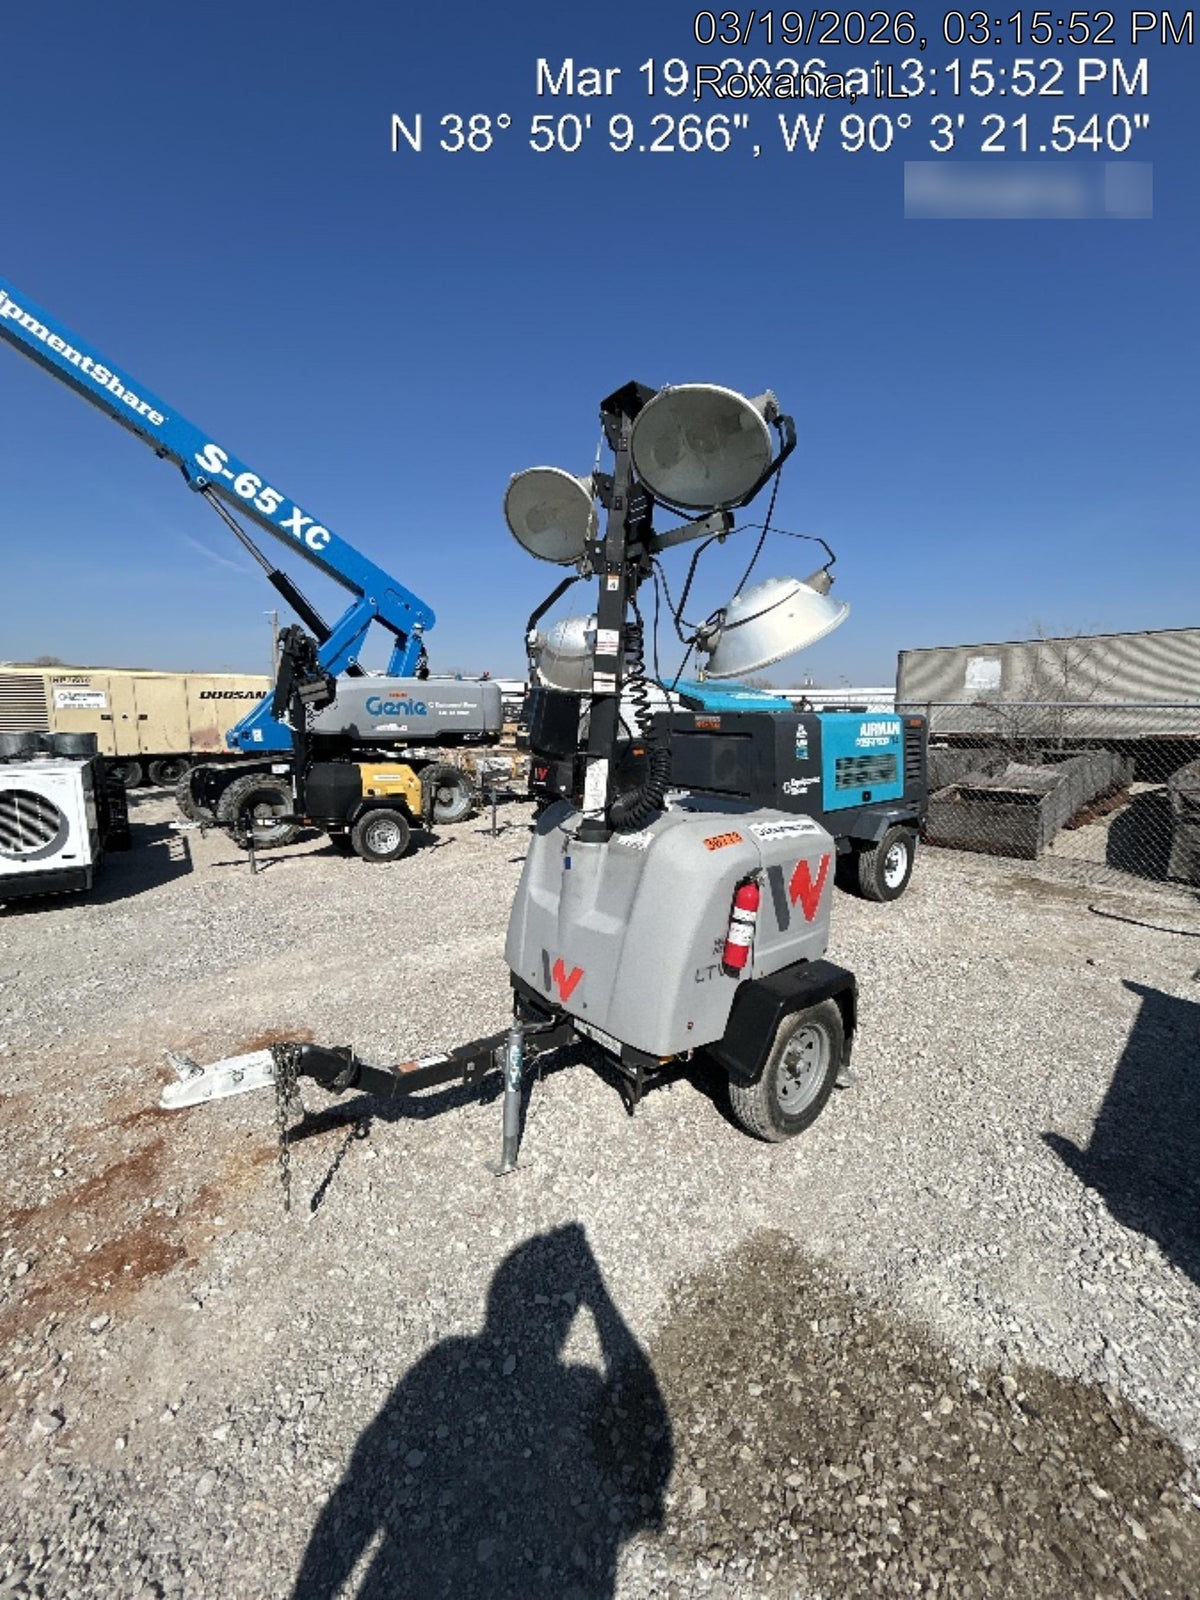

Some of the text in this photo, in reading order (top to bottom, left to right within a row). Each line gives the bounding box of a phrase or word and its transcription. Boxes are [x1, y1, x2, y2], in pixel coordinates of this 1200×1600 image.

[195, 443, 331, 550] S-65 XC
[365, 696, 427, 716] Genie
[860, 721, 900, 737] AIRMAN
